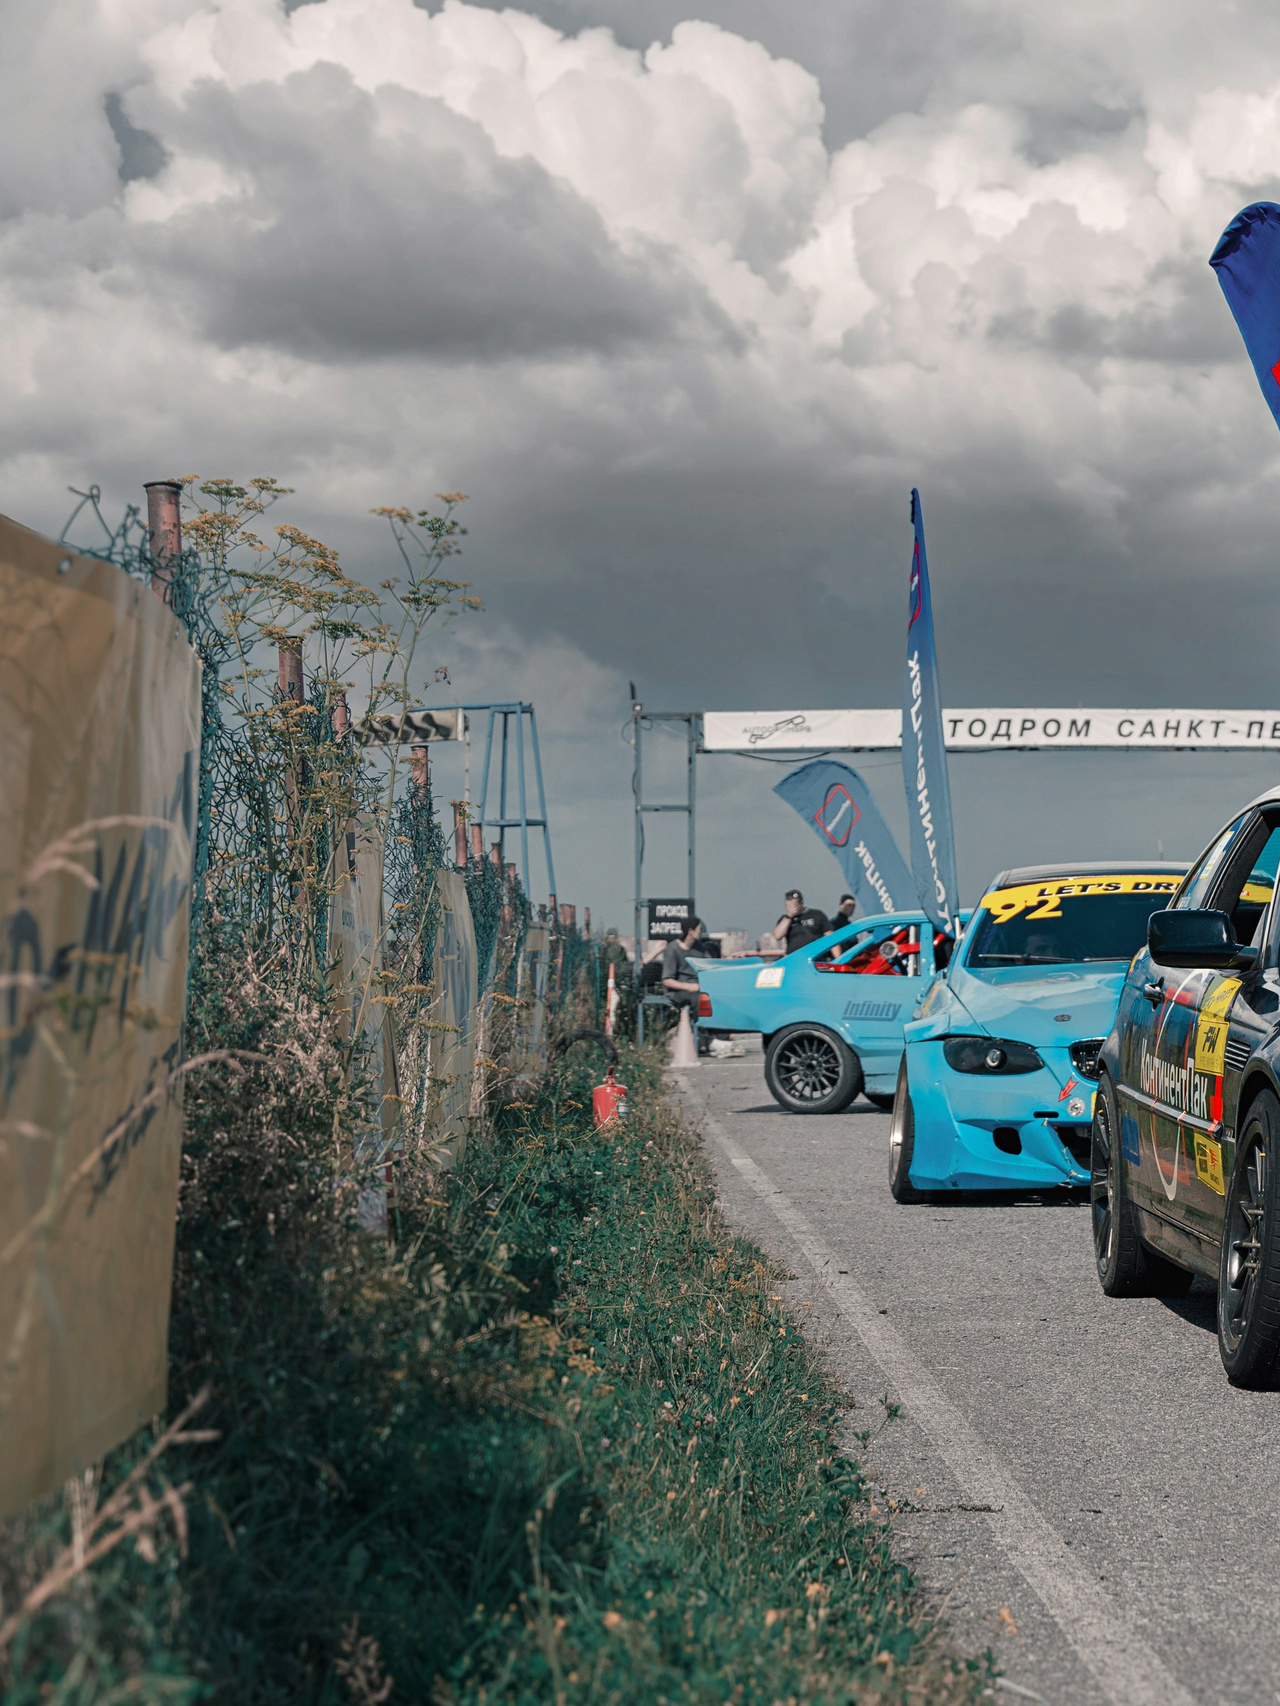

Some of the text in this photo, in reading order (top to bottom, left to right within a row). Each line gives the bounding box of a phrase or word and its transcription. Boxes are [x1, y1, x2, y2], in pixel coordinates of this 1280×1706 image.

[899, 718, 1092, 742] ТОДРОМ
[1038, 882, 1123, 896] LET'S
[990, 896, 1063, 924] 92
[843, 1001, 901, 1018] Infinity
[1140, 1038, 1208, 1119] КонтинентПак
